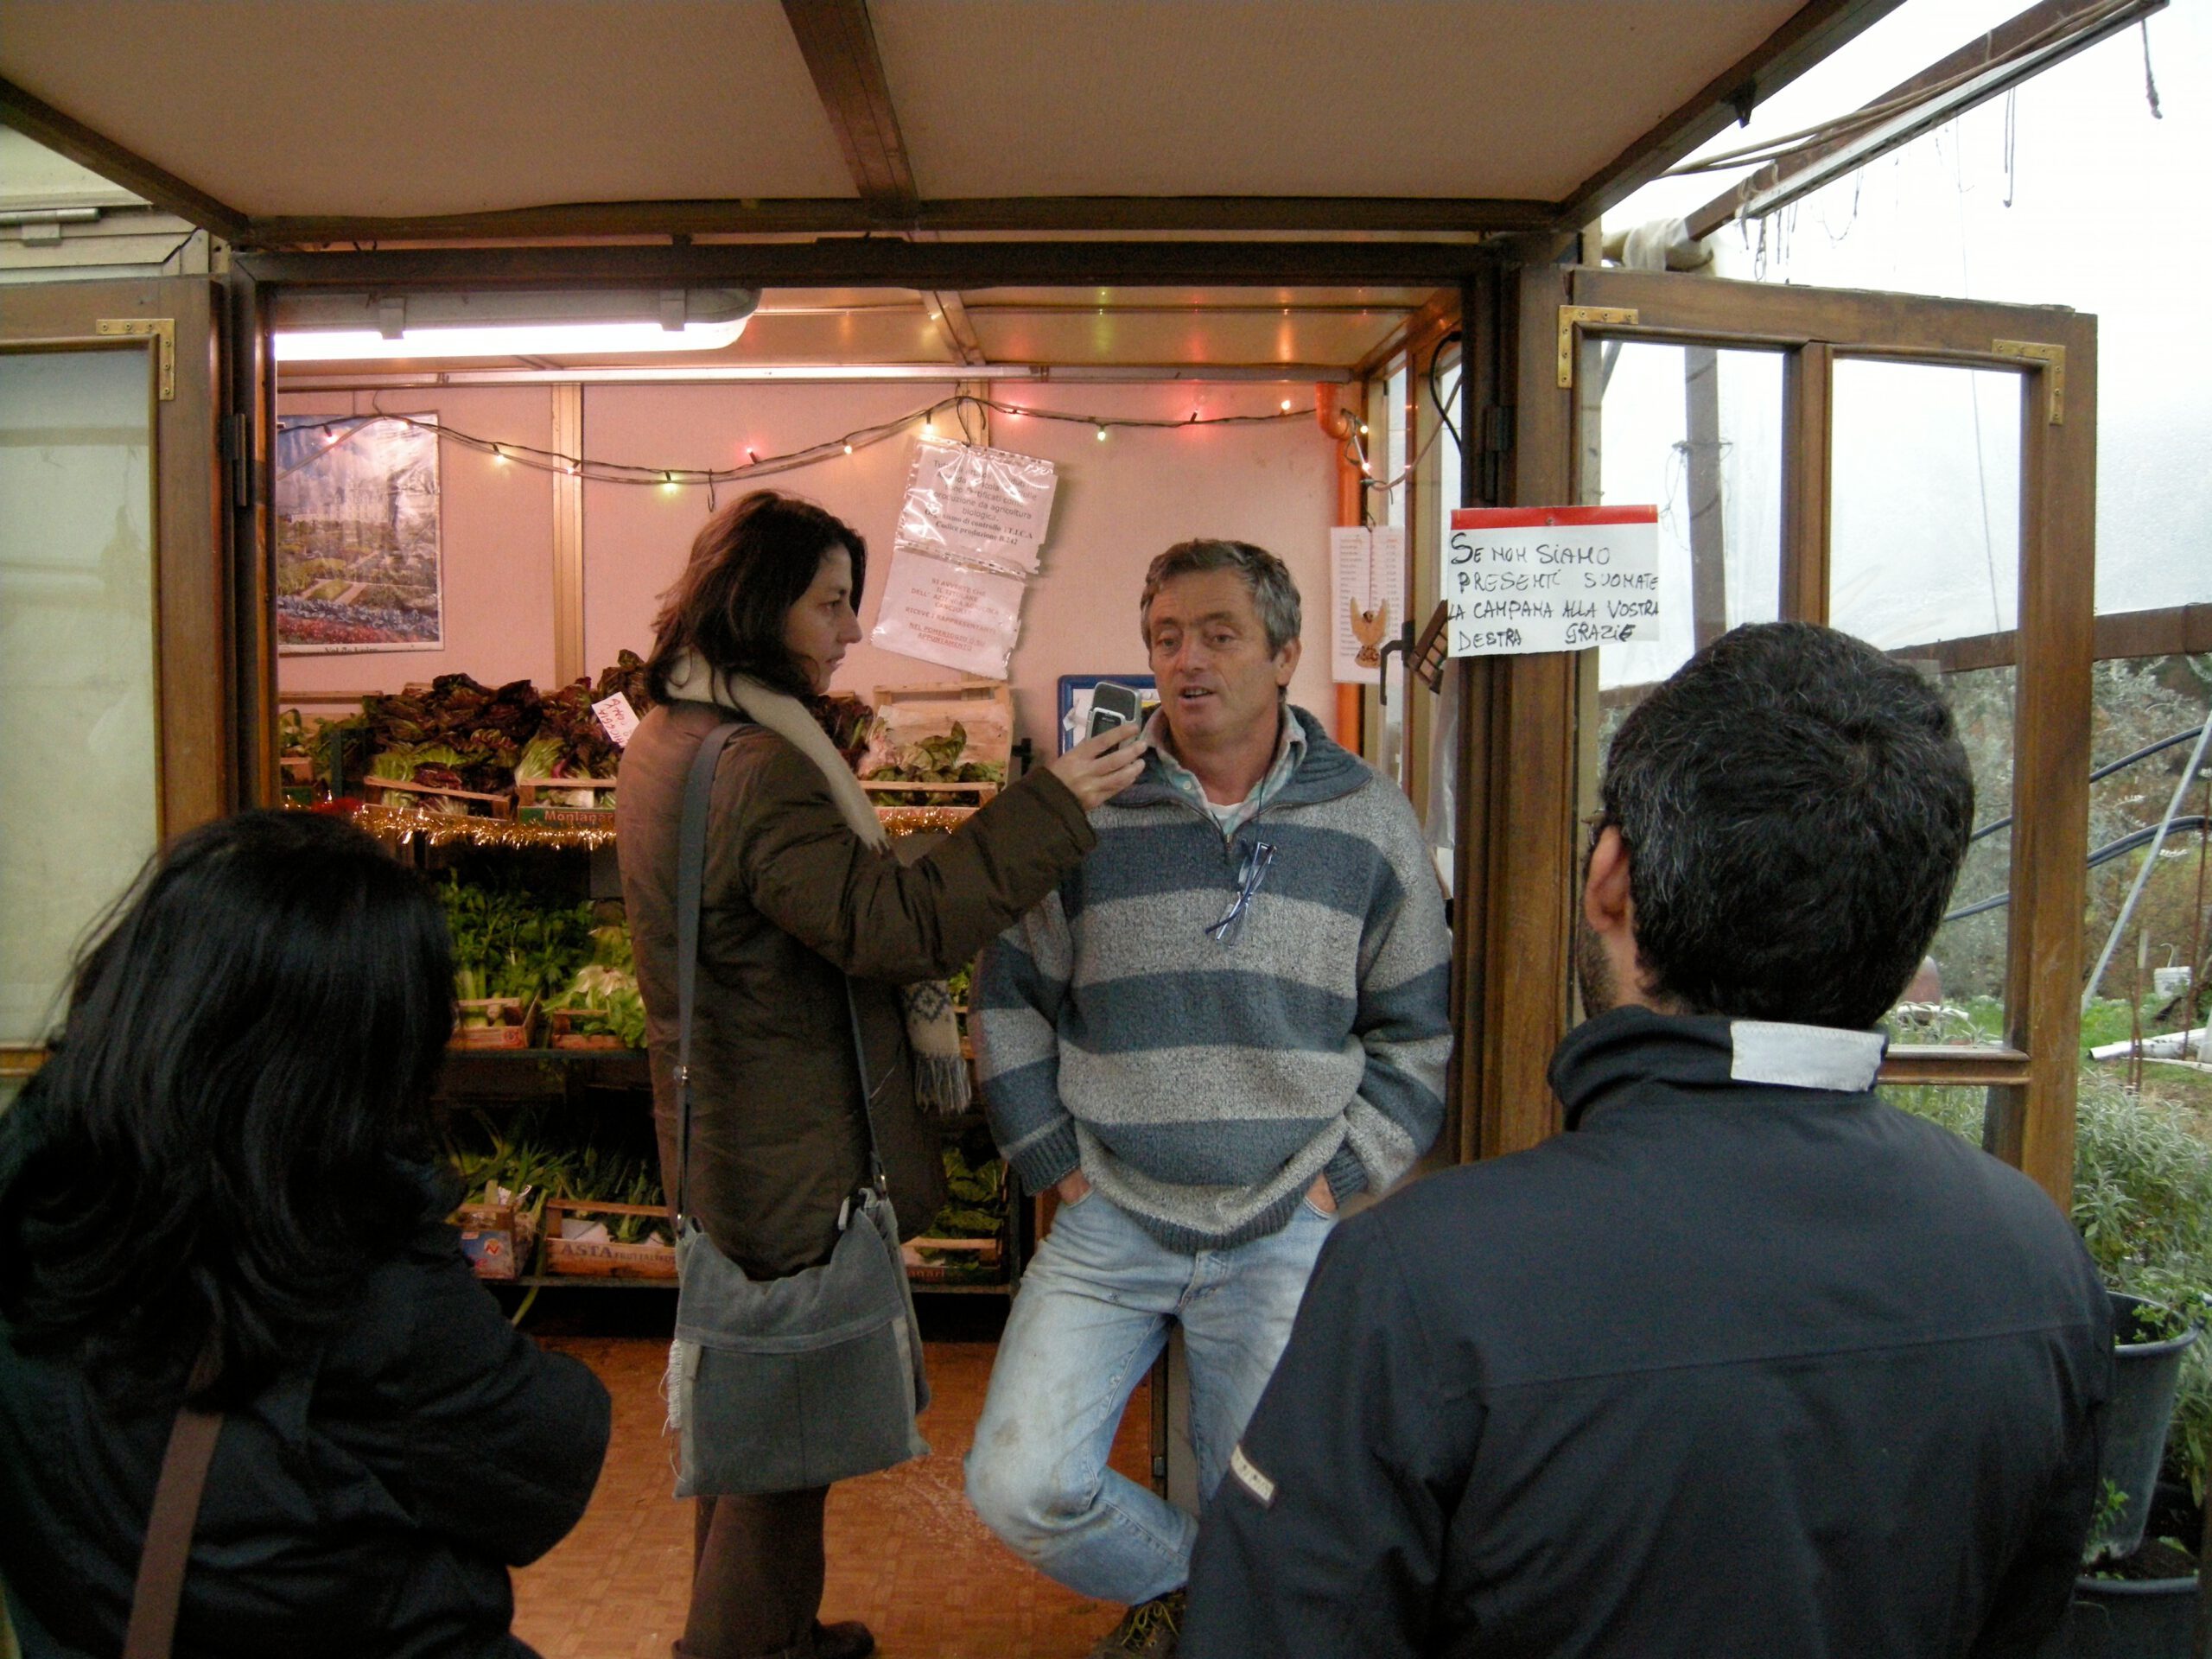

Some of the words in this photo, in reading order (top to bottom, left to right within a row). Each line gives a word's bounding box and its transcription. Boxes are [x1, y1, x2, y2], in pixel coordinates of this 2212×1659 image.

[1473, 600, 1554, 620] CAMPANA
[1561, 600, 1598, 619] ALLA
[1607, 599, 1659, 619] VOSTRA
[1459, 628, 1522, 652] DESTRA
[562, 1244, 612, 1258] ASTA
